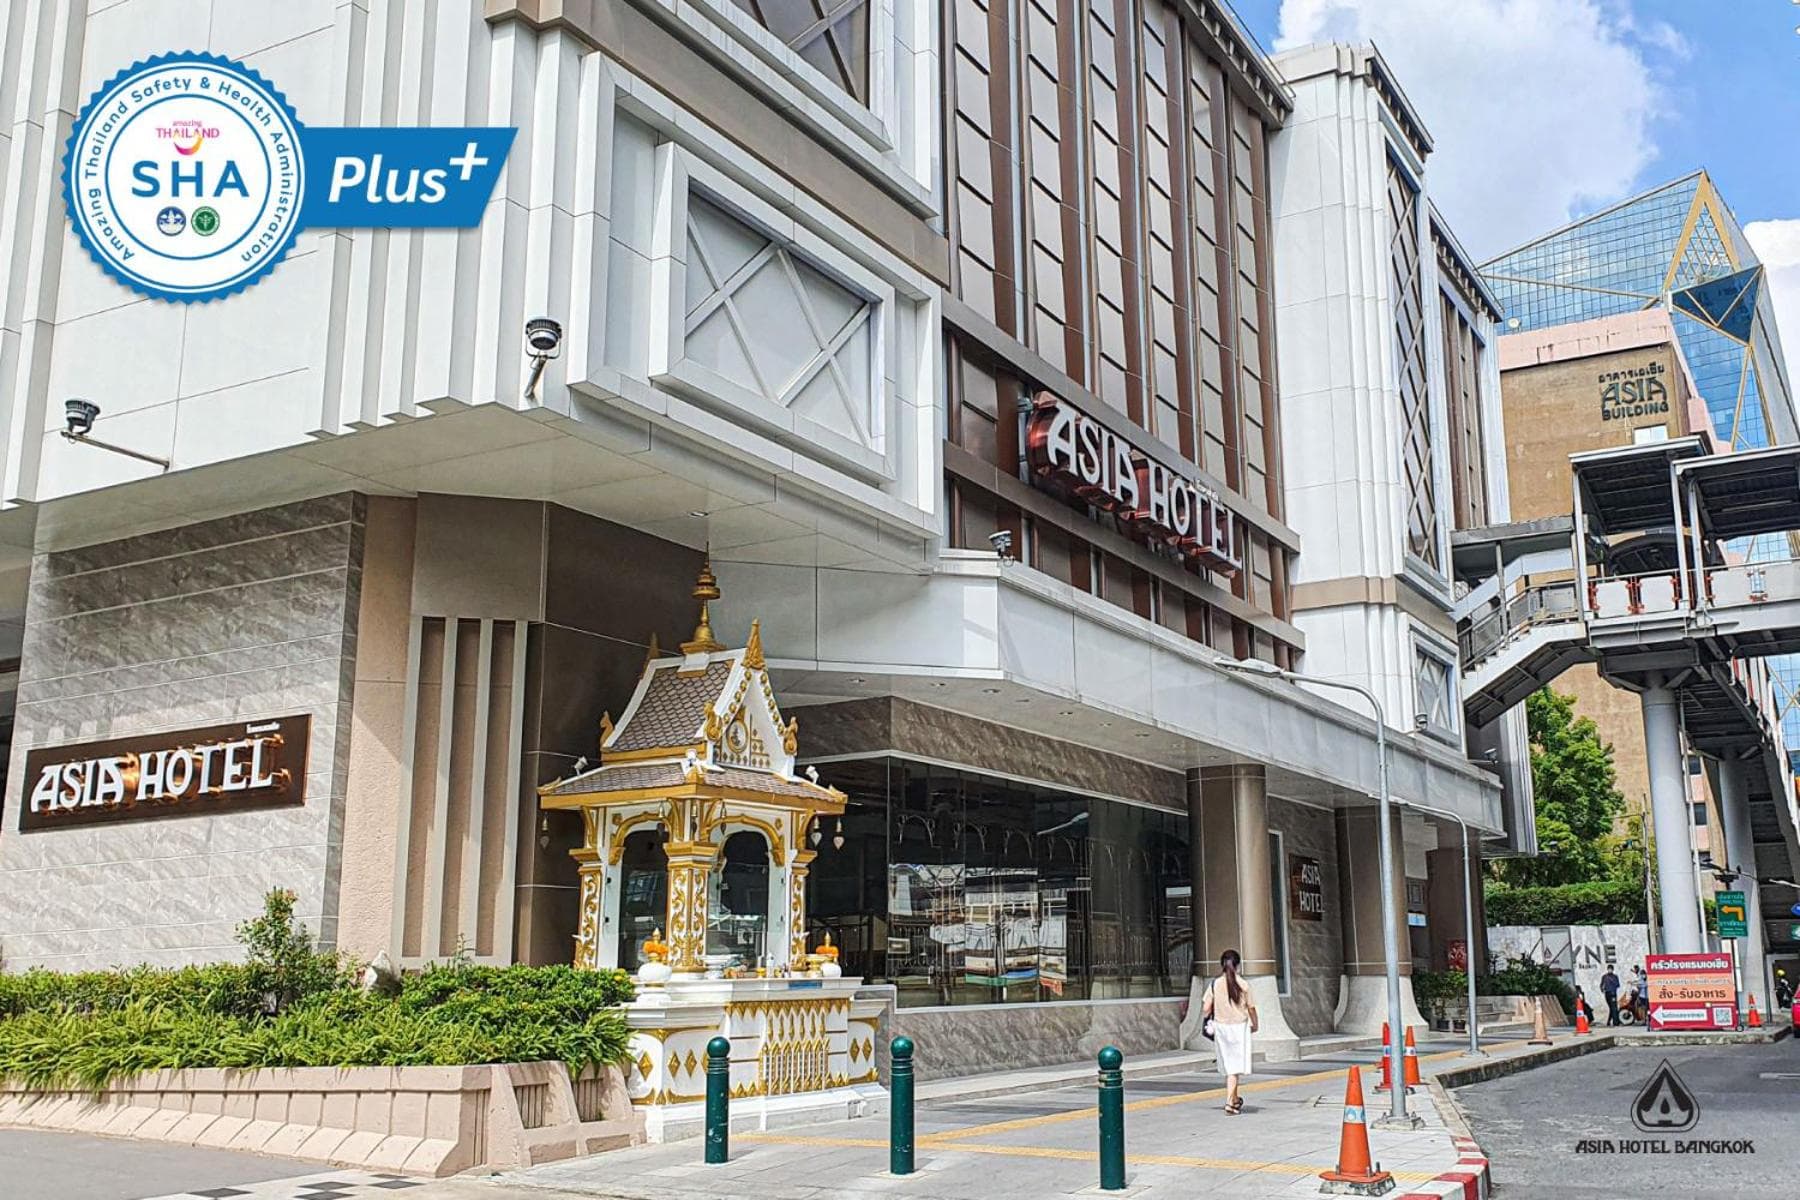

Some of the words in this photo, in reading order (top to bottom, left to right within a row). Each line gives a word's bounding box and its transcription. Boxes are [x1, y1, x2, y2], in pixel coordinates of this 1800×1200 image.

[1601, 376, 1668, 409] ASIA
[1601, 401, 1669, 421] BUILDING
[1047, 400, 1140, 509] ASIA
[1147, 457, 1243, 570] HOTEL
[31, 756, 125, 813] ASIA
[136, 738, 273, 801] HOTEL
[1301, 863, 1321, 886] ASIA
[1299, 890, 1326, 913] HOTEL
